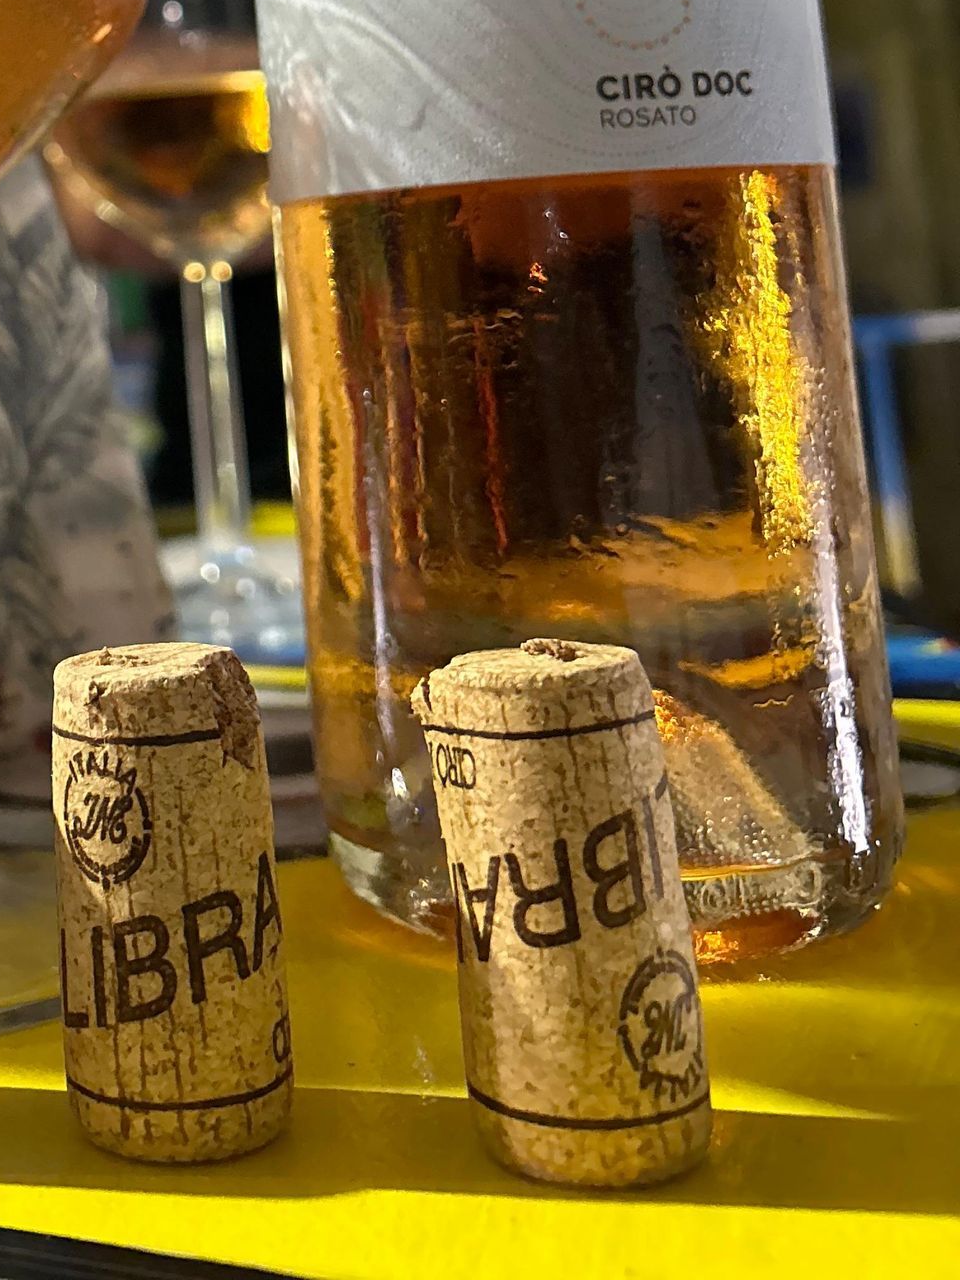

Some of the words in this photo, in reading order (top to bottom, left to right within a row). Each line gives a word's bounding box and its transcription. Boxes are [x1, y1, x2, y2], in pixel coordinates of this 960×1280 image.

[596, 65, 681, 101] CIRÒ
[692, 70, 754, 98] DOC
[600, 107, 697, 129] ROSATO
[68, 750, 137, 797] ITALIA
